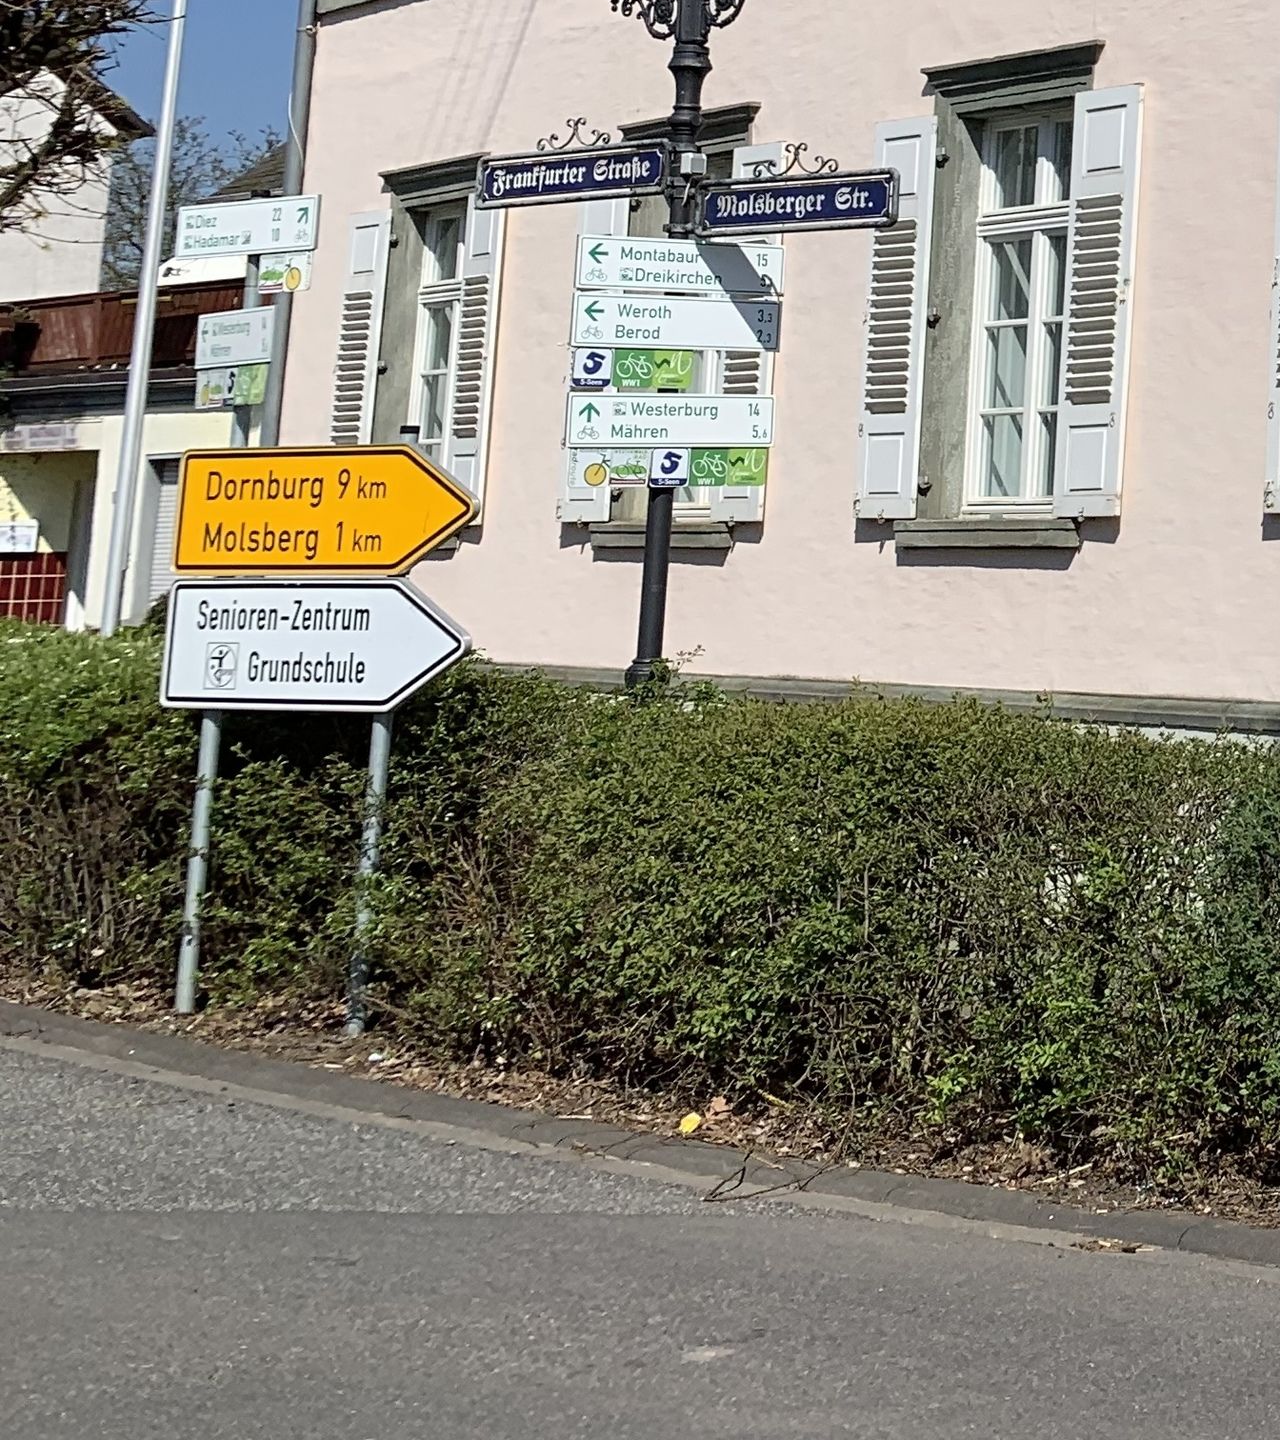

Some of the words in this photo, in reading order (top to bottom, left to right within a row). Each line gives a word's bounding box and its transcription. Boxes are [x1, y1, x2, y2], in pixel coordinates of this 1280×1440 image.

[492, 164, 587, 197] Frankfurter
[593, 157, 651, 184] Straße
[716, 192, 825, 218] Molsberger
[834, 188, 874, 209] Str.
[195, 215, 217, 229] Diez
[272, 208, 282, 222] 22
[193, 233, 240, 248] Hadamar
[620, 246, 701, 263] Montabaur
[756, 254, 768, 267] 15
[635, 268, 722, 285] Dreikirchen
[617, 303, 672, 319] Weroth
[757, 309, 773, 324] 3,3
[615, 325, 660, 340] Berod
[756, 329, 772, 344] 2,3
[631, 402, 719, 419] Westerburg
[748, 403, 760, 417] 14
[611, 424, 668, 439] Mähren
[752, 425, 768, 440] 5,6
[206, 469, 324, 508] Dornburg
[337, 468, 351, 499] 9
[357, 475, 387, 500] km
[201, 521, 319, 560] Molsberg
[335, 521, 344, 552] 1
[352, 529, 382, 552] km
[197, 599, 371, 631] Senioren-Zentrum
[247, 650, 365, 684] Grundschule
